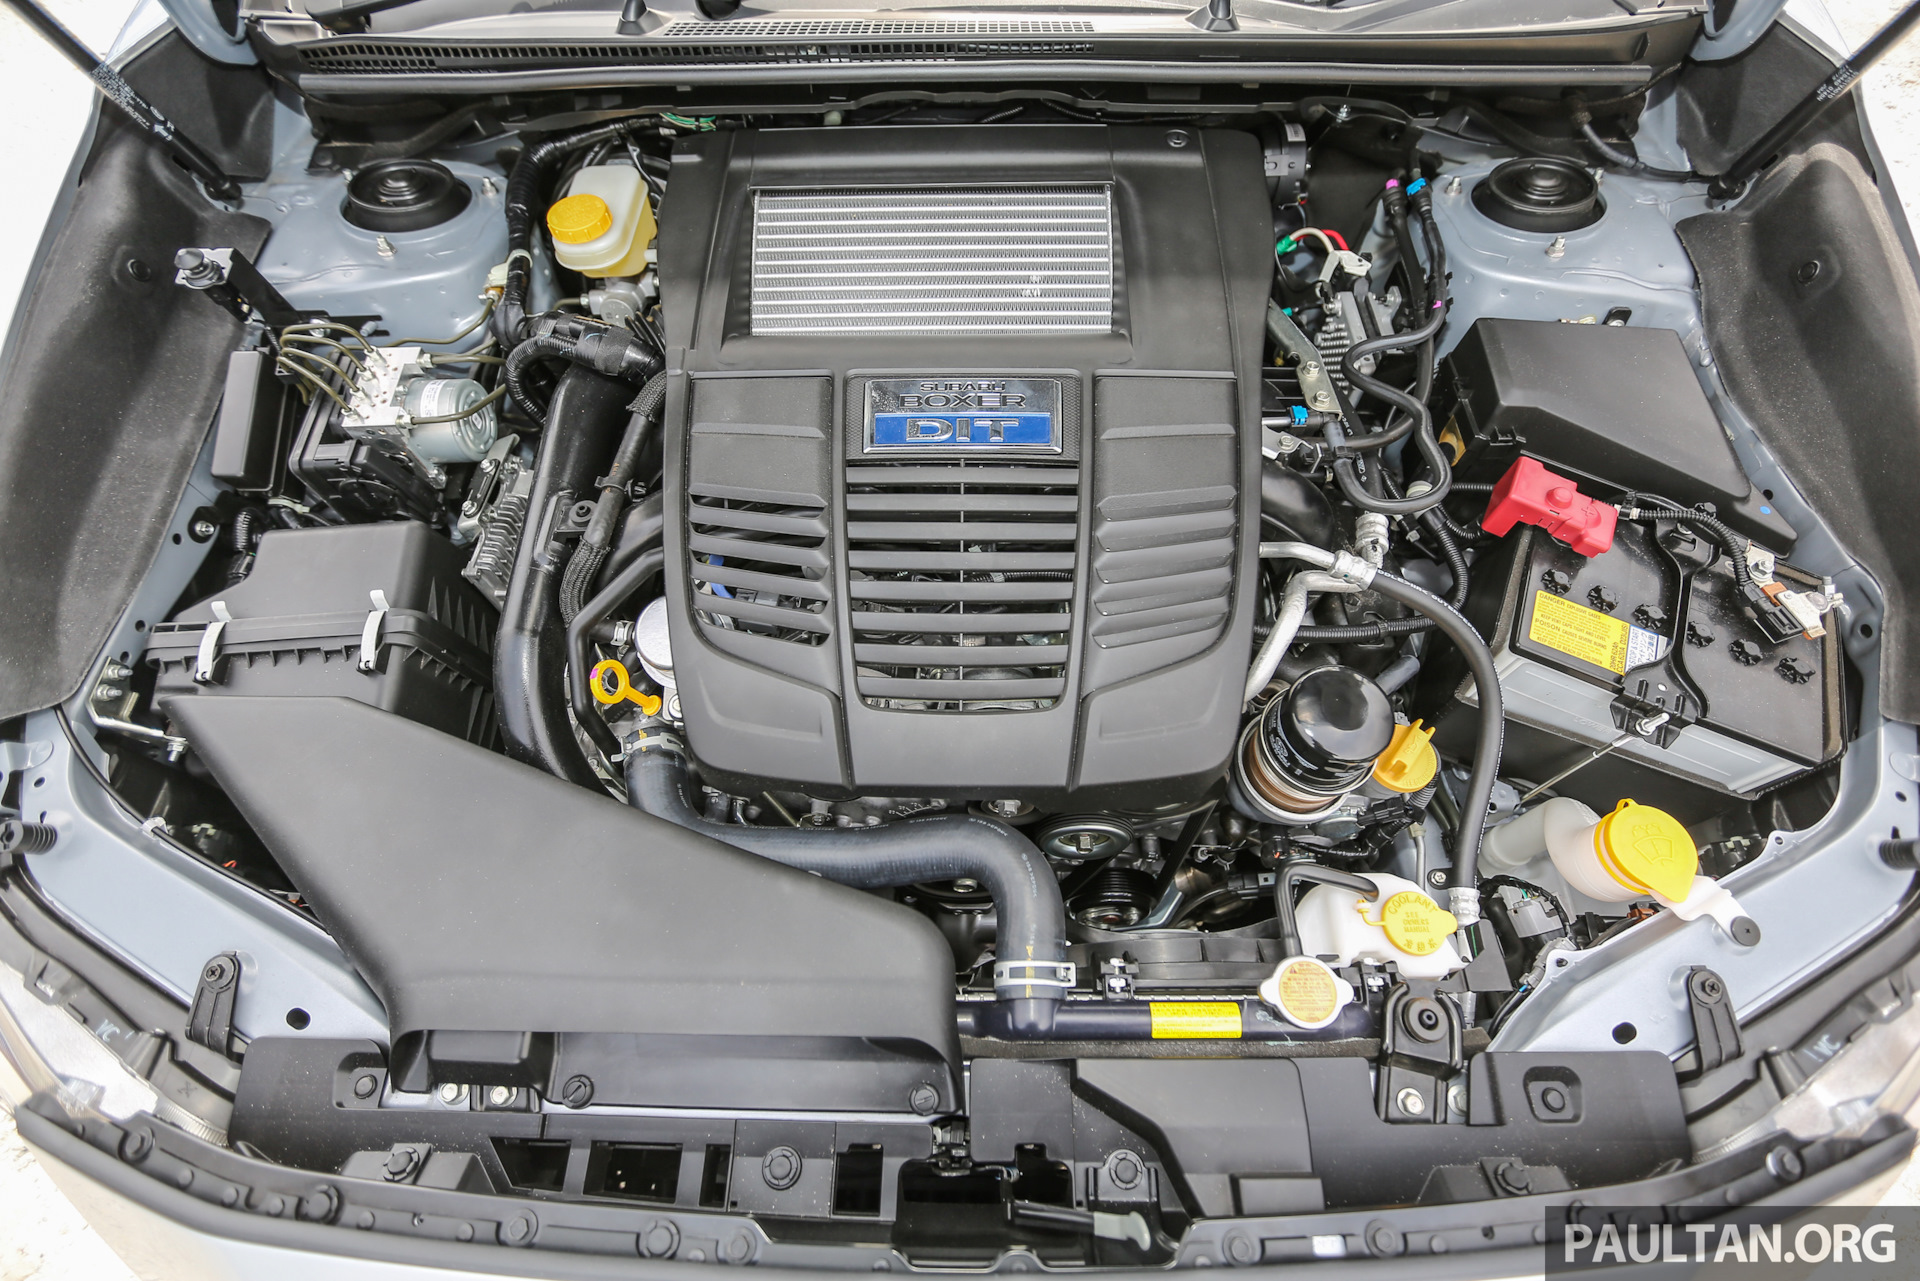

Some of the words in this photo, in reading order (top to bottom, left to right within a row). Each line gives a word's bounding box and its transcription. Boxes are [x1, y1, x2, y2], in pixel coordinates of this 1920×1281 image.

[920, 381, 1006, 392] SUBARU
[900, 393, 1026, 408] BOXER
[906, 418, 1020, 442] DIT
[1539, 592, 1565, 607] DANGER
[1535, 618, 1560, 632] POISON
[1631, 628, 1640, 646] START
[1629, 650, 1637, 665] STOP
[1388, 894, 1438, 914] COOLANT
